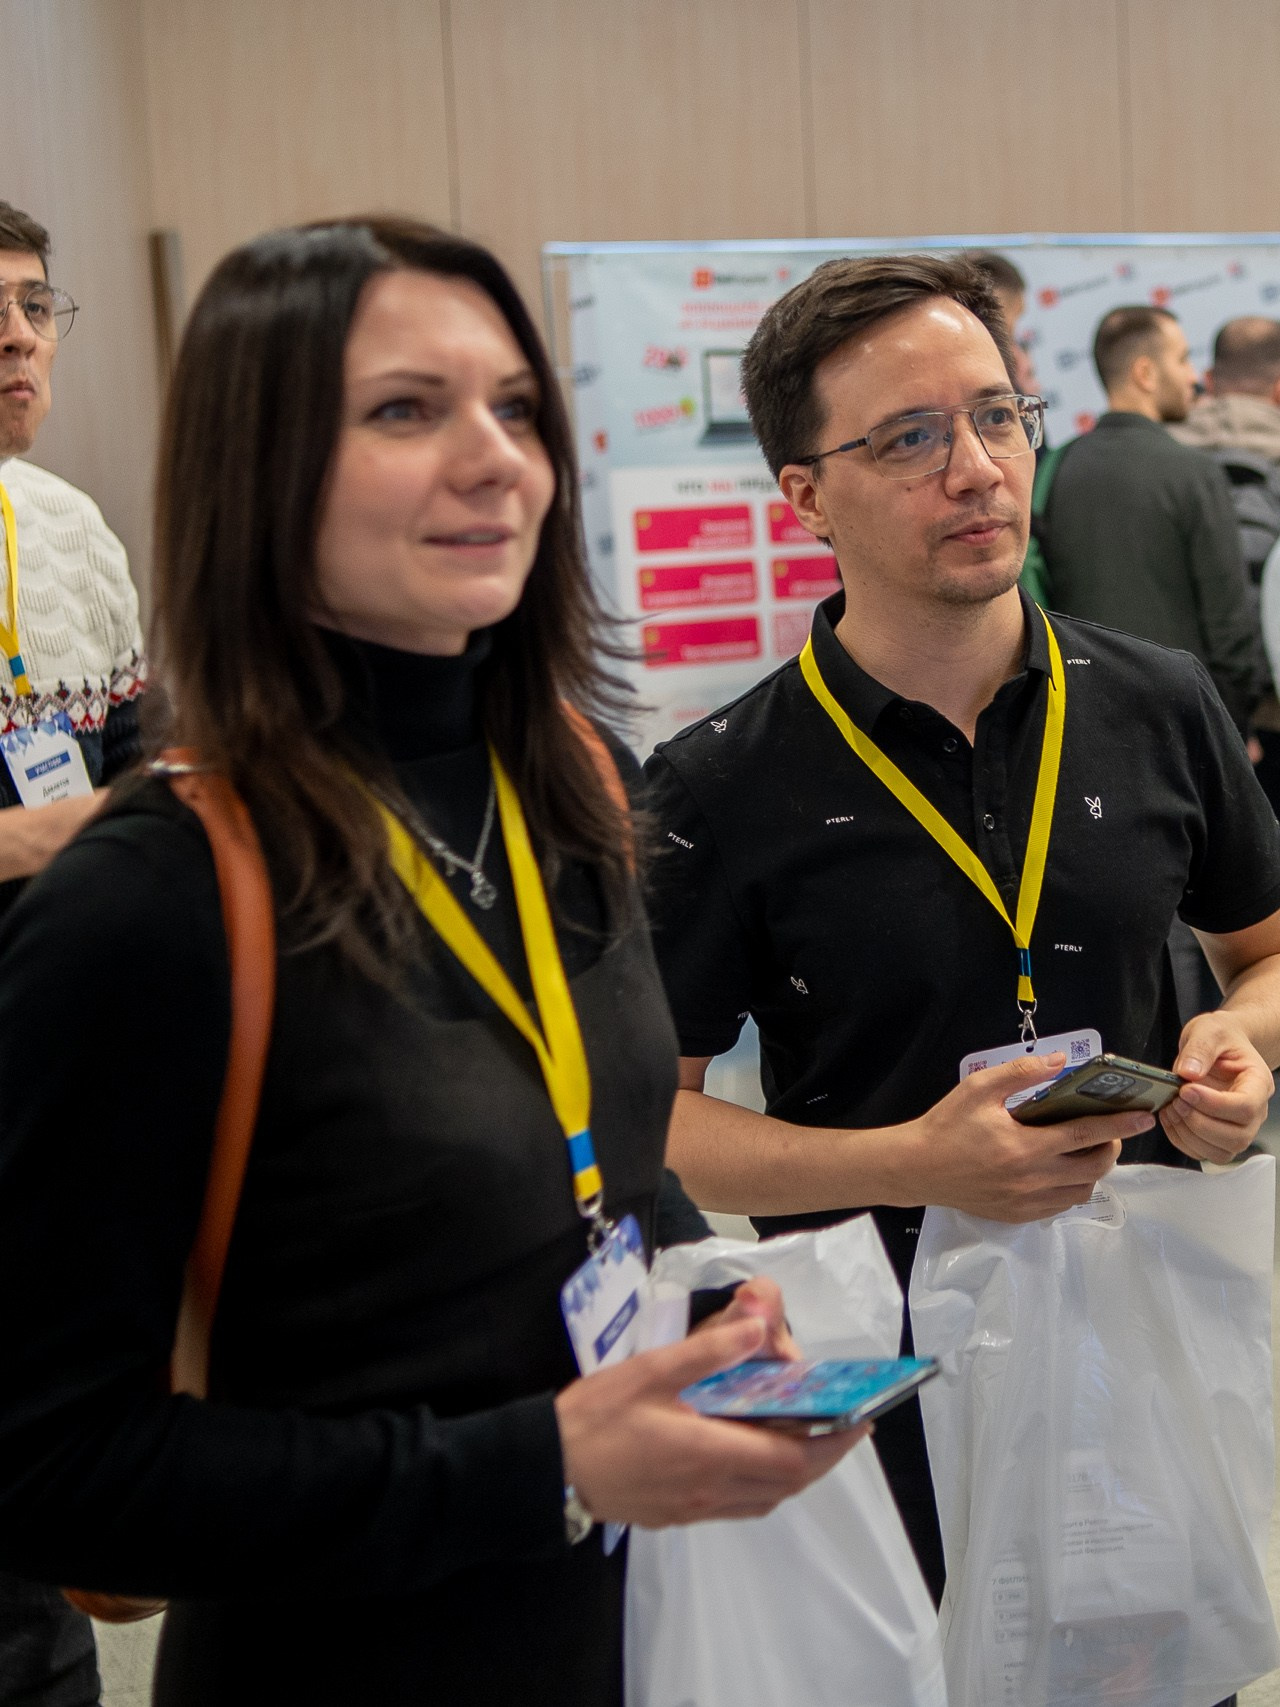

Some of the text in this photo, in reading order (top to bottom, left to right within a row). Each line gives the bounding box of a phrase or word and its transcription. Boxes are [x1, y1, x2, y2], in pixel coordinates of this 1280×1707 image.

[826, 815, 854, 825] PTERLY
[667, 831, 694, 850] PTERLY
[1054, 943, 1083, 953] PTERLY
[905, 1227, 919, 1235] PTE
